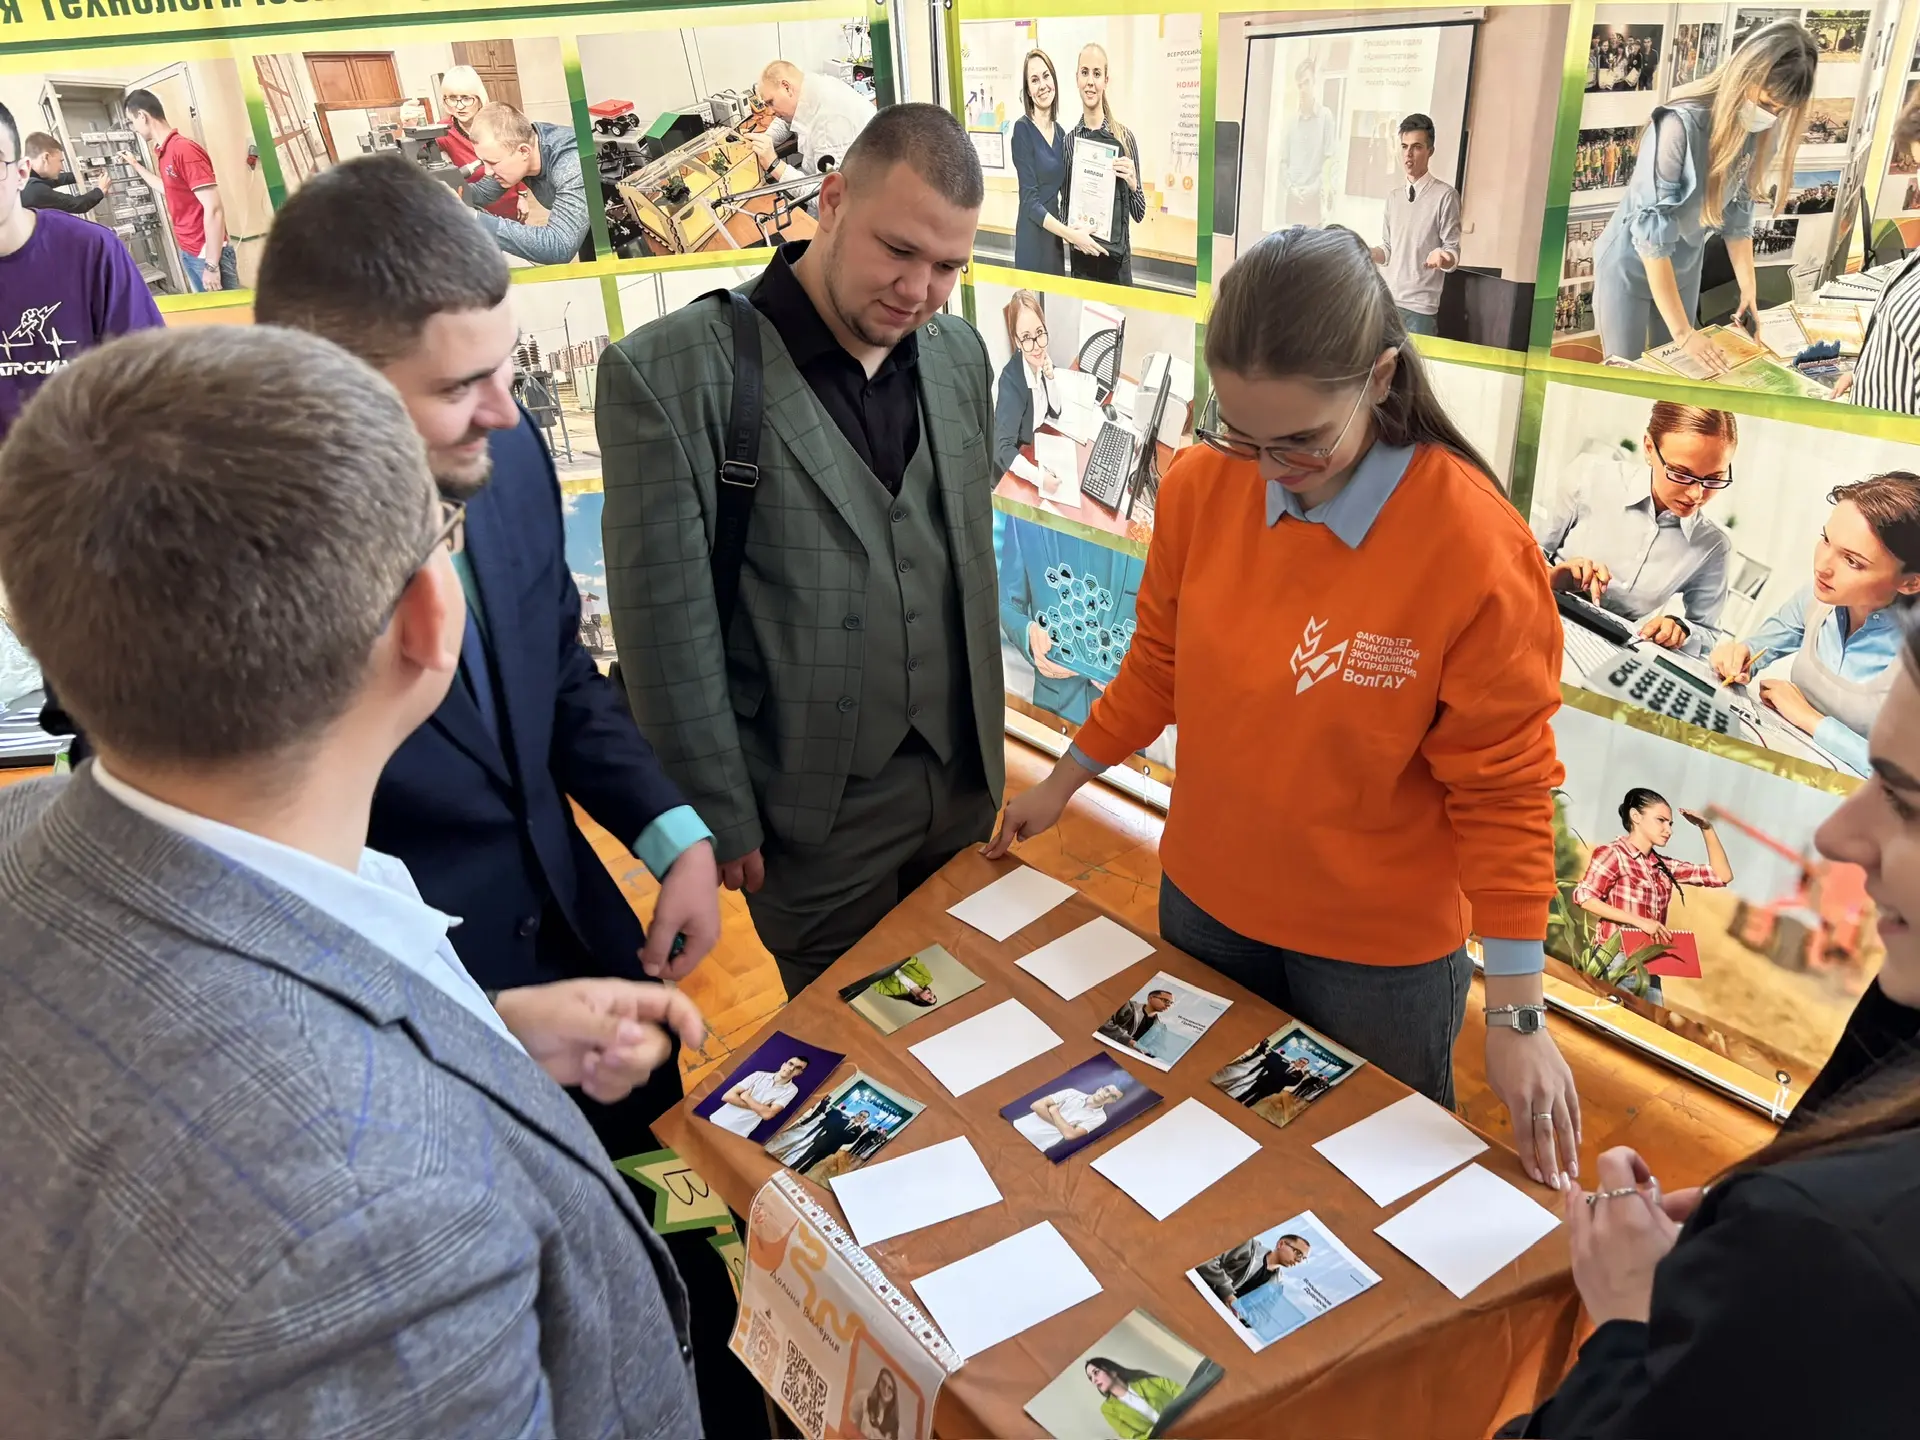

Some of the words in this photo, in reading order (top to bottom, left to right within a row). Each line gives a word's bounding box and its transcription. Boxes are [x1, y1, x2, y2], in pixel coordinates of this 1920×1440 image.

[1352, 639, 1420, 660] ПРИКЛАДНОЙ
[1356, 631, 1412, 648] ФАКУЛЬТЕТ
[1347, 657, 1355, 667] И
[1356, 659, 1417, 679] УПРАВЛЕНИЯ
[1349, 648, 1413, 667] ЭКОНОМИКИ
[1342, 668, 1406, 689] ВолГАУ
[769, 1268, 801, 1309] Долина
[802, 1305, 840, 1354] Валерия
